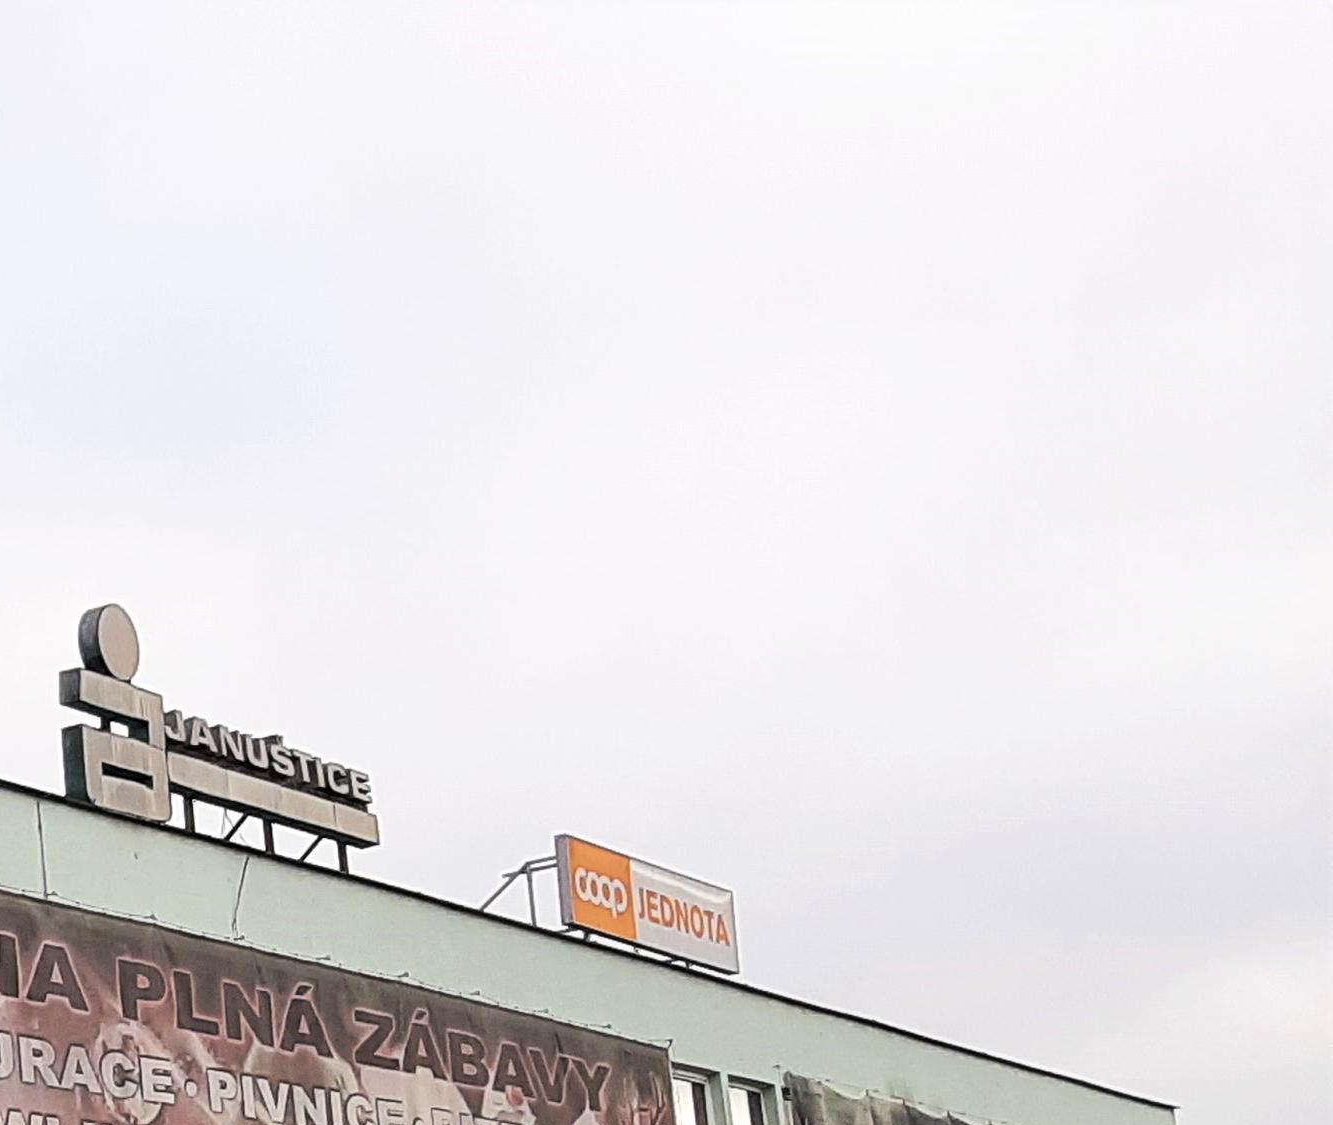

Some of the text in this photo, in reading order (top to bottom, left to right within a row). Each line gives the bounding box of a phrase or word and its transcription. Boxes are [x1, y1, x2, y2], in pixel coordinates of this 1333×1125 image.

[574, 867, 730, 946] coop JEDNOTA
[116, 957, 334, 1057] PLNÁ
[352, 1007, 611, 1111] ZÁBAVY
